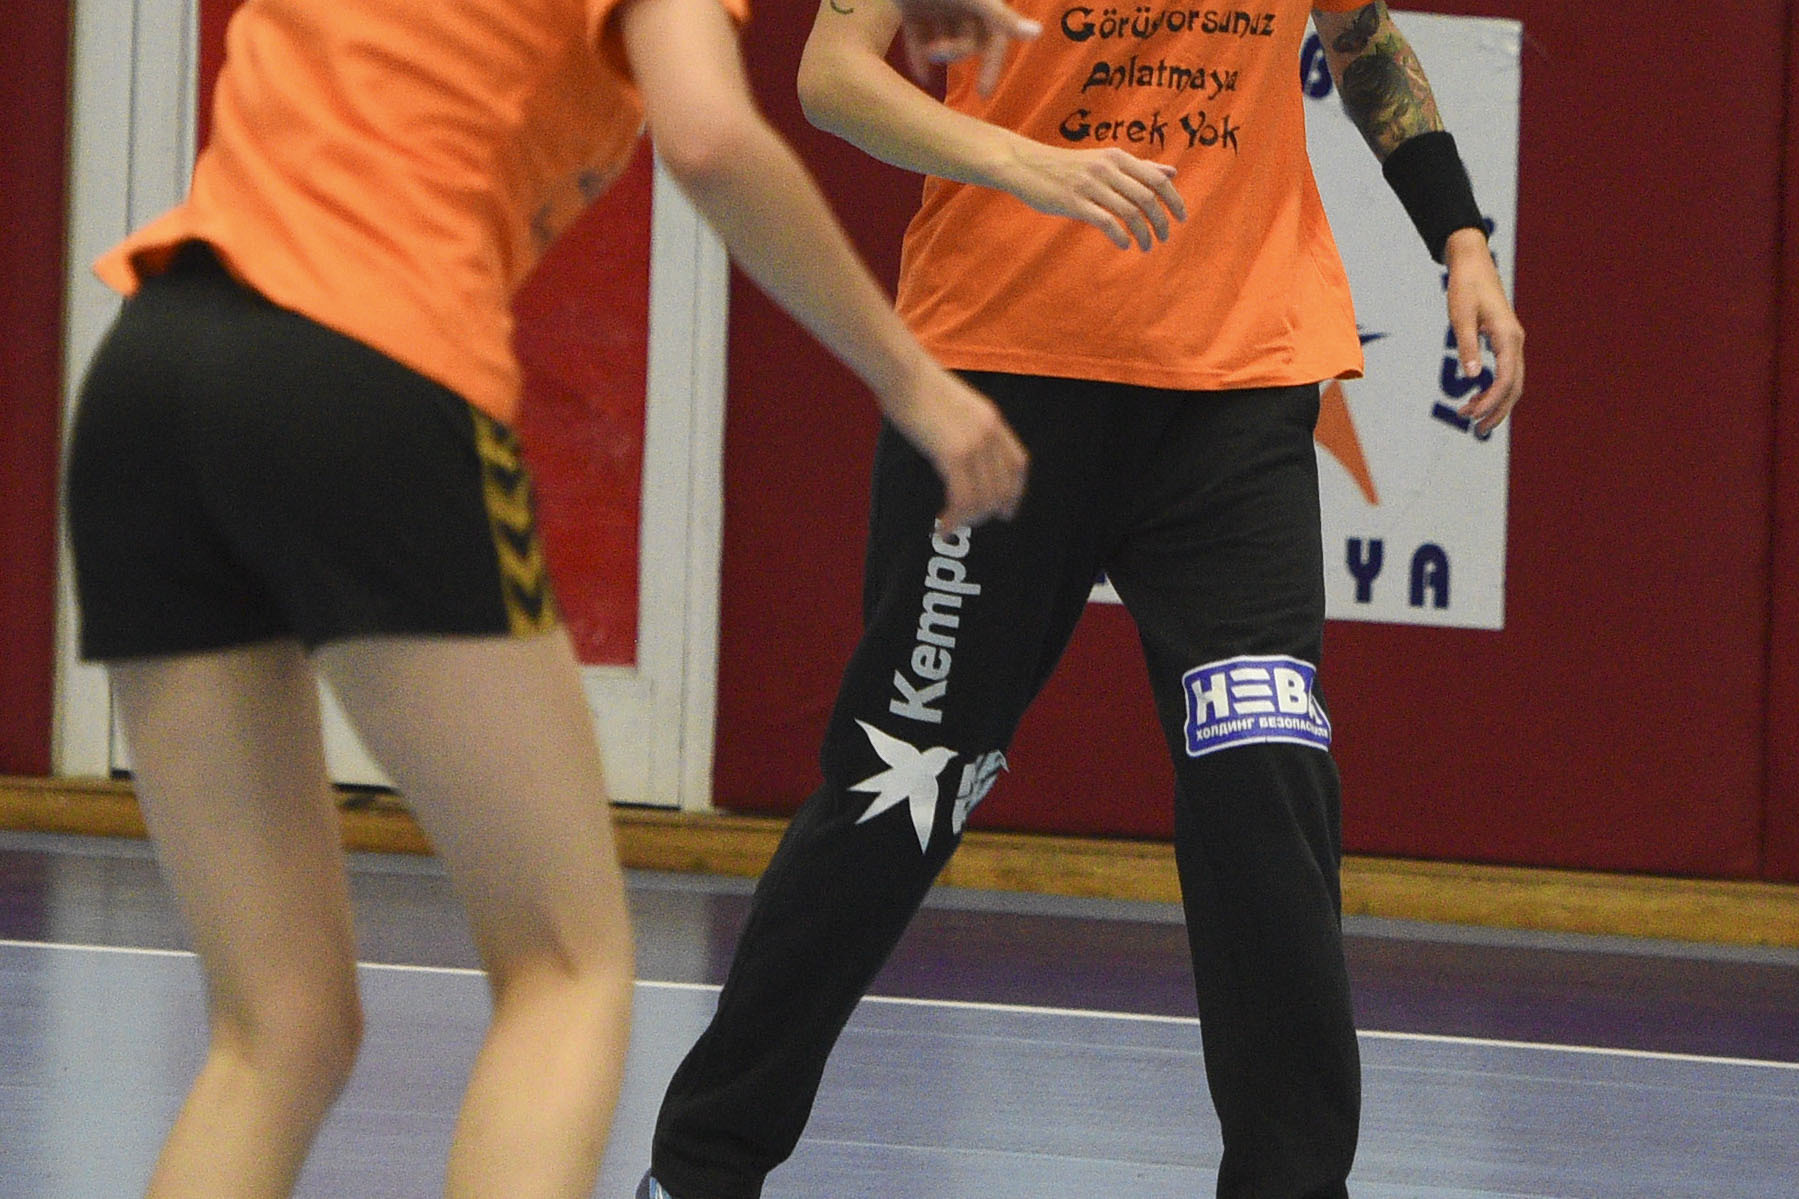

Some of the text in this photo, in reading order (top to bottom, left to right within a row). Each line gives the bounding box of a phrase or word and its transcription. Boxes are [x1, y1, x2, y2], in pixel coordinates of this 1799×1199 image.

[1058, 107, 1241, 157] Gerek Yok
[888, 517, 983, 725] Kempa
[1196, 716, 1255, 742] ХОЛДИНГ
